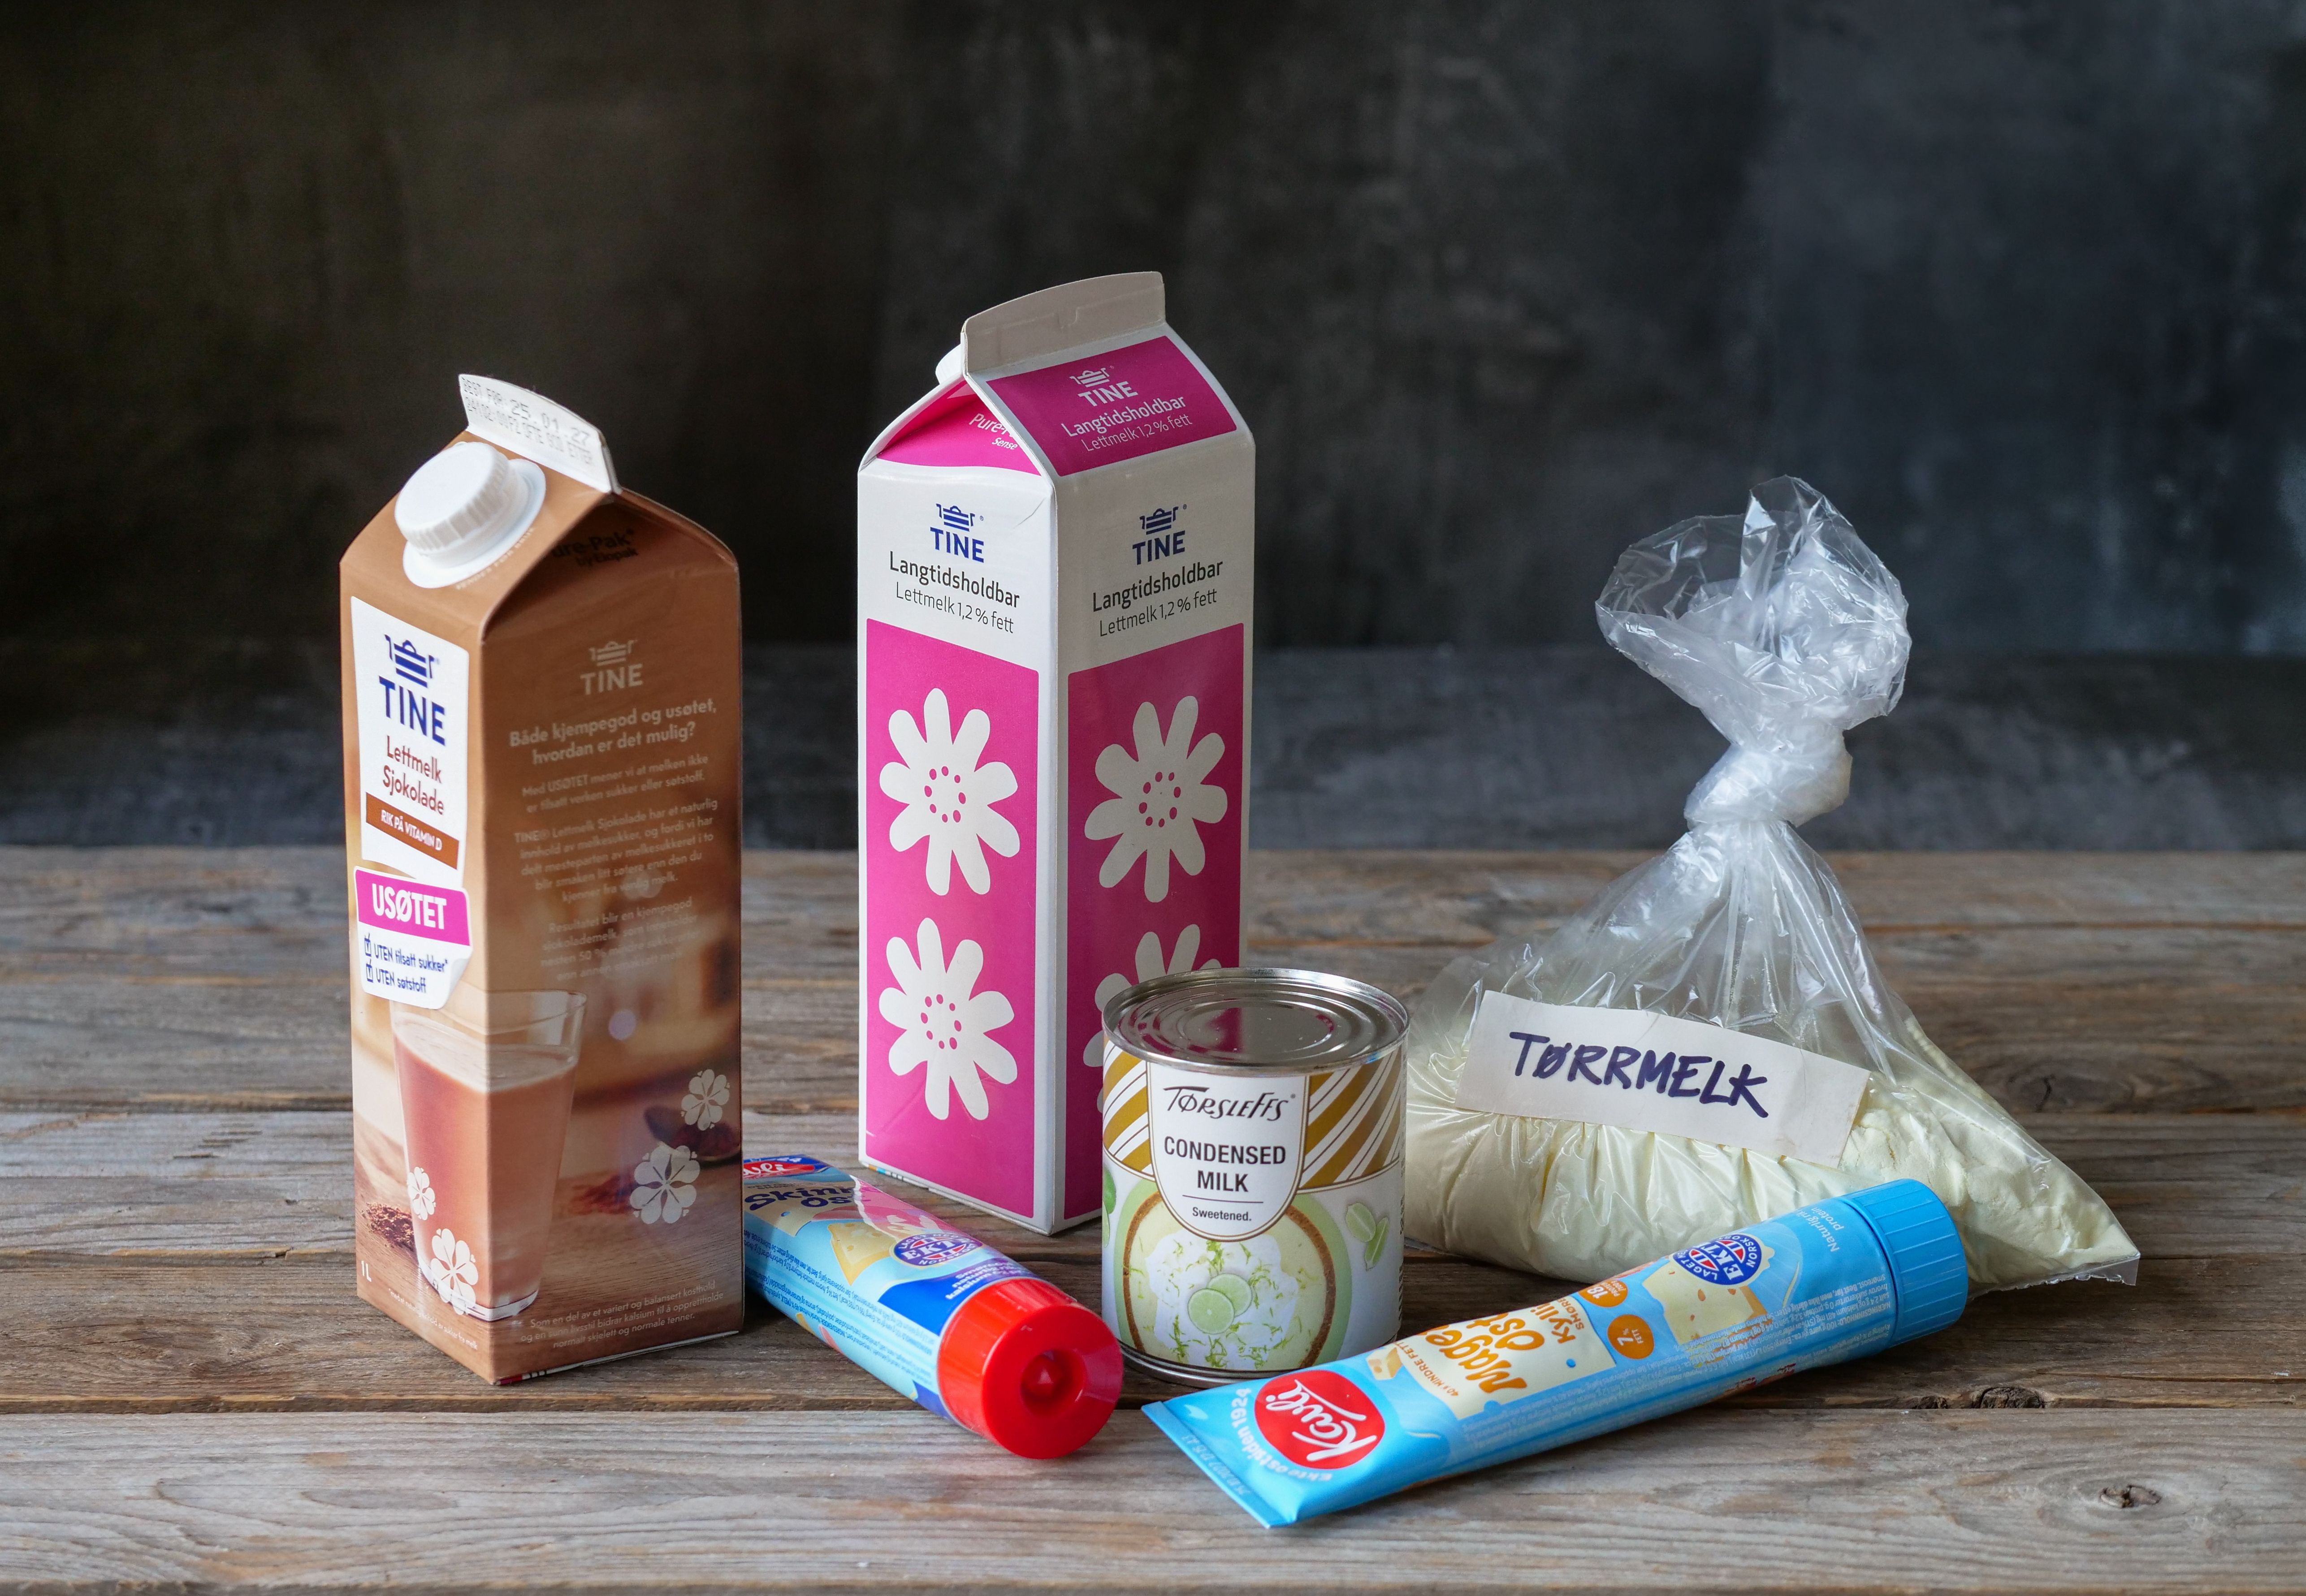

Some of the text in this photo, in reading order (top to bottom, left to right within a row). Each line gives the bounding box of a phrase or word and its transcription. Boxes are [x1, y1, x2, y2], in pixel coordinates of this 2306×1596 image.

[1077, 381, 1138, 406] TINE
[969, 413, 1013, 437] Pure-
[1061, 397, 1186, 437] Langtidsholdbar
[1081, 414, 1193, 452] Lettmelk 1,2 % fett
[991, 437, 1018, 450] Sense
[552, 531, 630, 557] ure-Pak
[930, 527, 984, 563] TINE
[1132, 530, 1185, 565] TINE
[890, 551, 1020, 608] Langtidsholdbar
[1093, 561, 1223, 612] Langtidsholdbar
[896, 582, 1014, 634] Lettmelk 1,2 % fett
[1100, 588, 1217, 637] Lettmelk 1,2 % fett
[580, 663, 644, 695] TINE
[379, 676, 445, 746] TINE
[509, 697, 717, 747] Både kjempegod og usøtet,
[532, 720, 696, 764] hvordan er det mulig?
[387, 735, 441, 783] Lettmelk
[547, 774, 588, 791] USØTET
[636, 766, 646, 775] at
[649, 757, 685, 772] melken
[688, 752, 708, 766] ikke
[383, 765, 444, 815] Sjokolade
[641, 777, 662, 791] eller
[381, 810, 442, 850] RIK PÅ VITAMIN D
[598, 810, 646, 831] Sjokolade
[649, 807, 666, 820] har
[668, 806, 678, 816] et
[680, 797, 717, 815] naturlig
[645, 814, 713, 839] og fordi har
[625, 835, 695, 856] melkesukkeret
[704, 833, 714, 841] to
[647, 859, 665, 869] enn
[668, 853, 687, 866] den
[689, 849, 702, 861] du
[372, 884, 447, 929] USØTET
[602, 910, 619, 923] blir
[621, 910, 634, 920] en
[636, 897, 692, 919] kjempegod
[374, 944, 393, 962] UTEN
[395, 949, 415, 967] tilsatt
[376, 967, 394, 986] UTEN
[1509, 1031, 1768, 1118] TØRRMELK
[1164, 1136, 1287, 1165] CONDENSED
[1197, 1170, 1248, 1193] MILK
[1192, 1206, 1252, 1221] Sweetened.
[1811, 1207, 1844, 1230] protein
[898, 1234, 926, 1249] LAGET
[1806, 1216, 1839, 1252] Naturlig
[918, 1252, 962, 1265] NORSK
[1740, 1238, 1757, 1268] NORSK
[361, 1260, 372, 1282] 1L
[1681, 1260, 1718, 1280] LAGET
[531, 1316, 549, 1328] Som
[553, 1316, 563, 1324] en
[566, 1311, 579, 1321] del
[593, 1308, 600, 1316] et
[603, 1302, 629, 1314] variert
[631, 1301, 641, 1311] og
[644, 1290, 681, 1306] balansert
[683, 1280, 715, 1297] kosthold
[1587, 1285, 1608, 1299] 18
[1804, 1283, 1887, 1317] hvorav sukkerarter protein
[1836, 1292, 1889, 1316] salt kalsium
[1844, 1284, 1857, 1294] Best
[520, 1333, 532, 1343] og
[535, 1331, 545, 1339] en
[548, 1327, 567, 1337] sunn
[571, 1320, 595, 1333] livsstil
[597, 1315, 622, 1327] bidrar
[624, 1308, 654, 1321] kalsium
[673, 1292, 723, 1312] opprettholde
[553, 1312, 695, 1347] normalt skjelett og normale tenner.
[1530, 1302, 1576, 1344] Kylli
[1557, 1299, 1584, 1330] SMØRE
[1826, 1321, 1836, 1330] 100
[1466, 1312, 1545, 1350] Ost
[1631, 1329, 1644, 1344] FETT
[1415, 1359, 1445, 1387] MINDRE
[1230, 1388, 1251, 1428] 1924
[1265, 1379, 1378, 1461] Kavli
